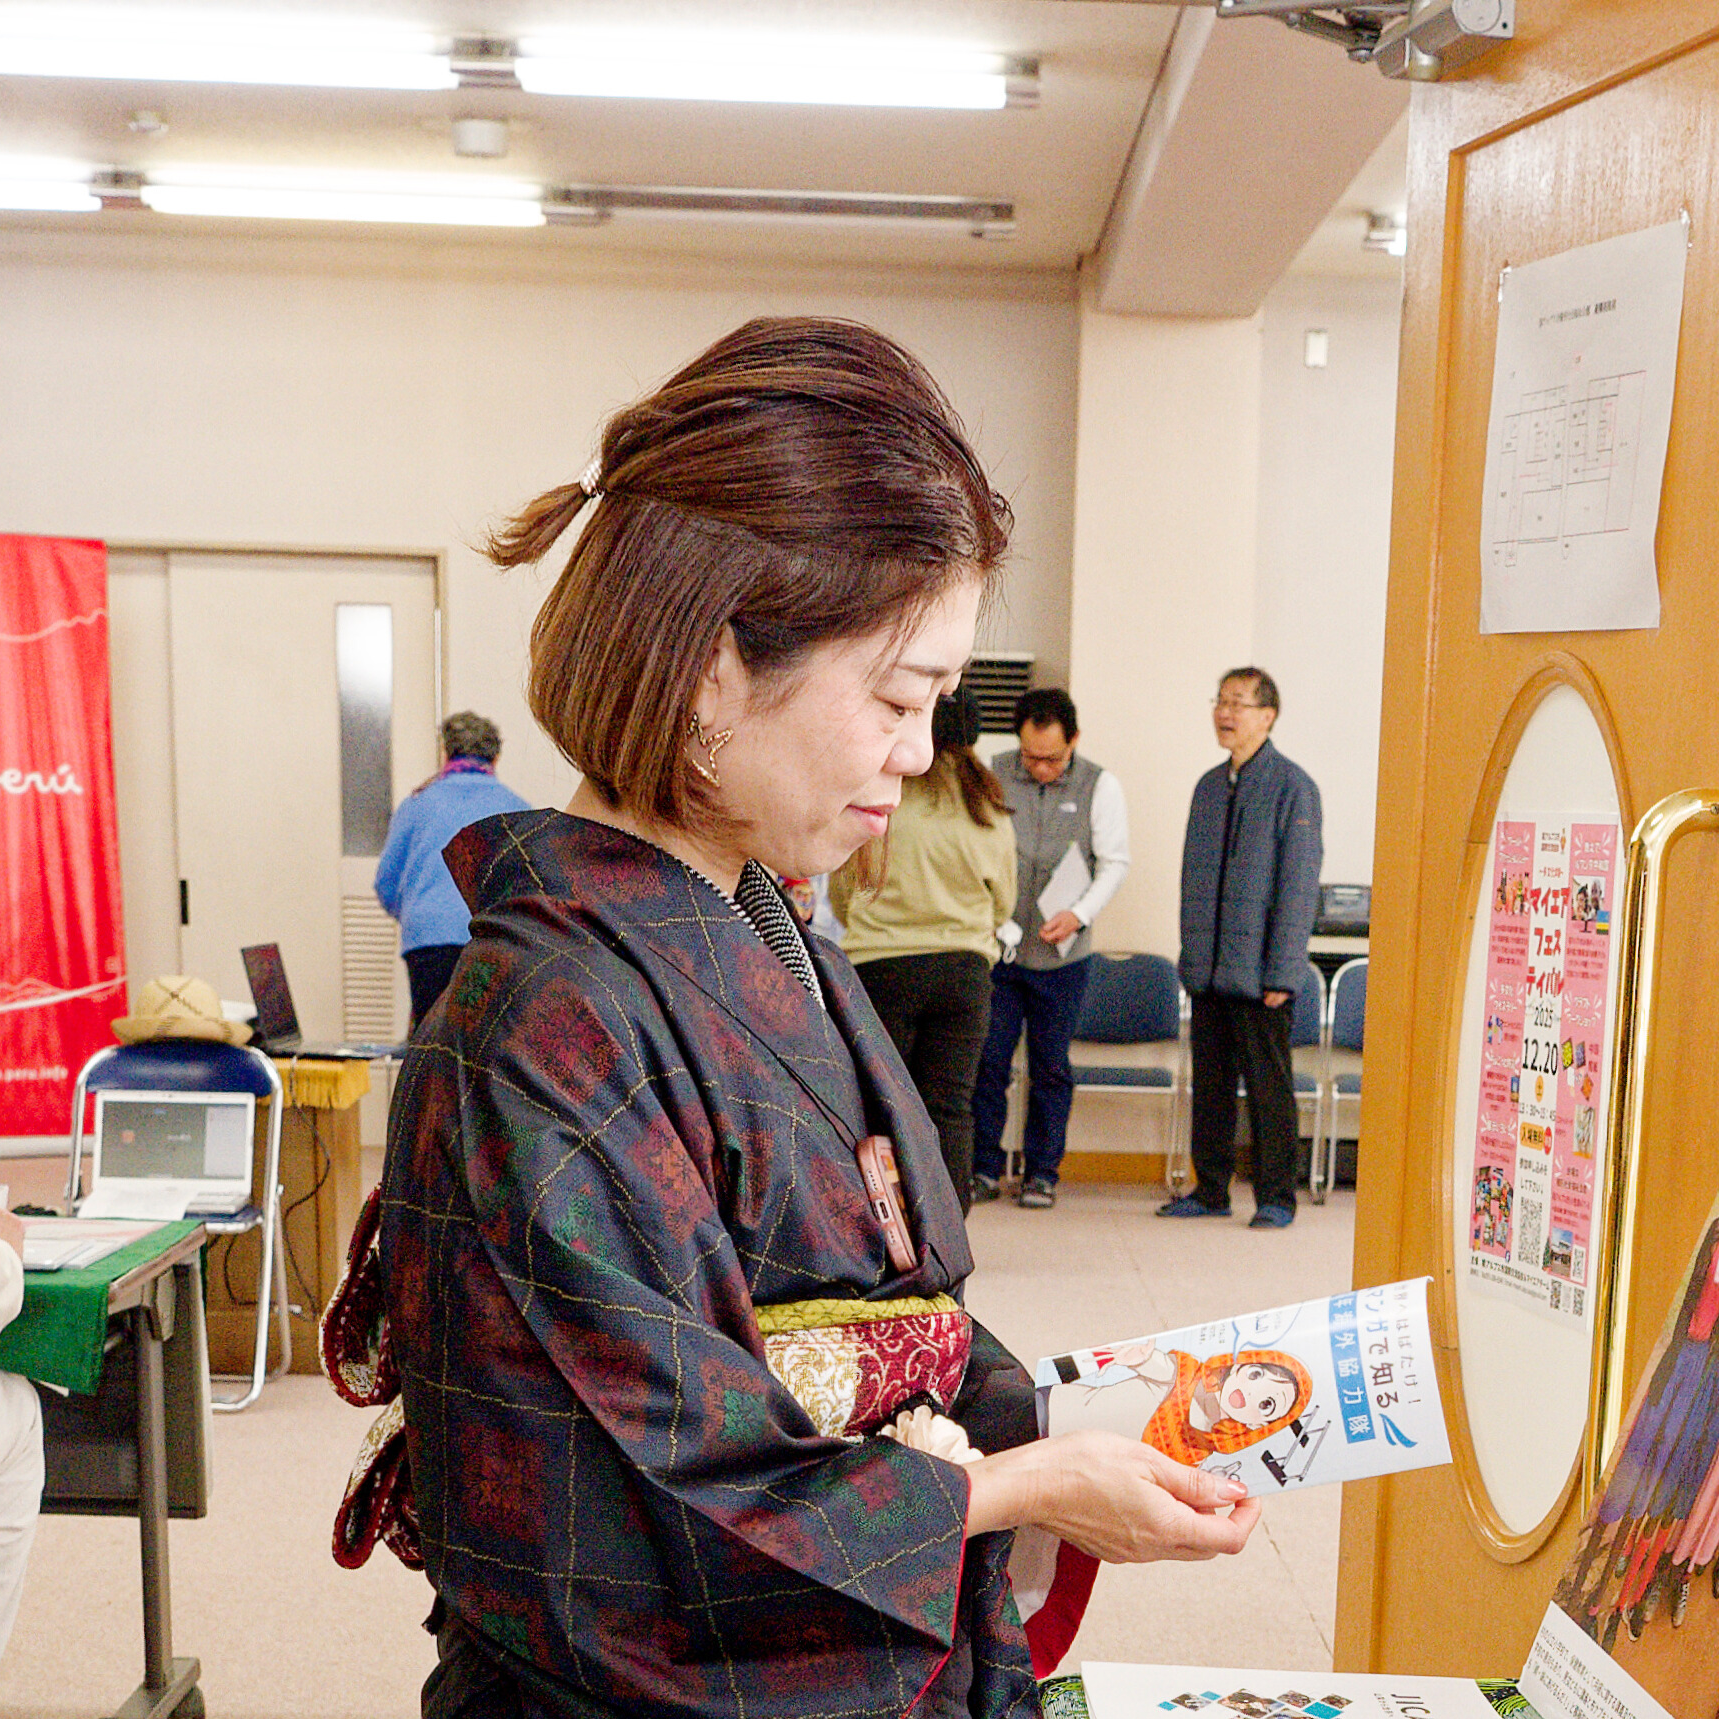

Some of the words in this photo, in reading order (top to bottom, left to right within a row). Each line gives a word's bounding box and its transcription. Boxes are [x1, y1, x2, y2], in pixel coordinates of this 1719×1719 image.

[1530, 887, 1571, 918] マイエア
[1534, 927, 1561, 956] フェス
[1533, 1006, 1554, 1028] 2025
[1522, 1037, 1559, 1076] 12.20
[1331, 1295, 1373, 1436] 年海外協力隊
